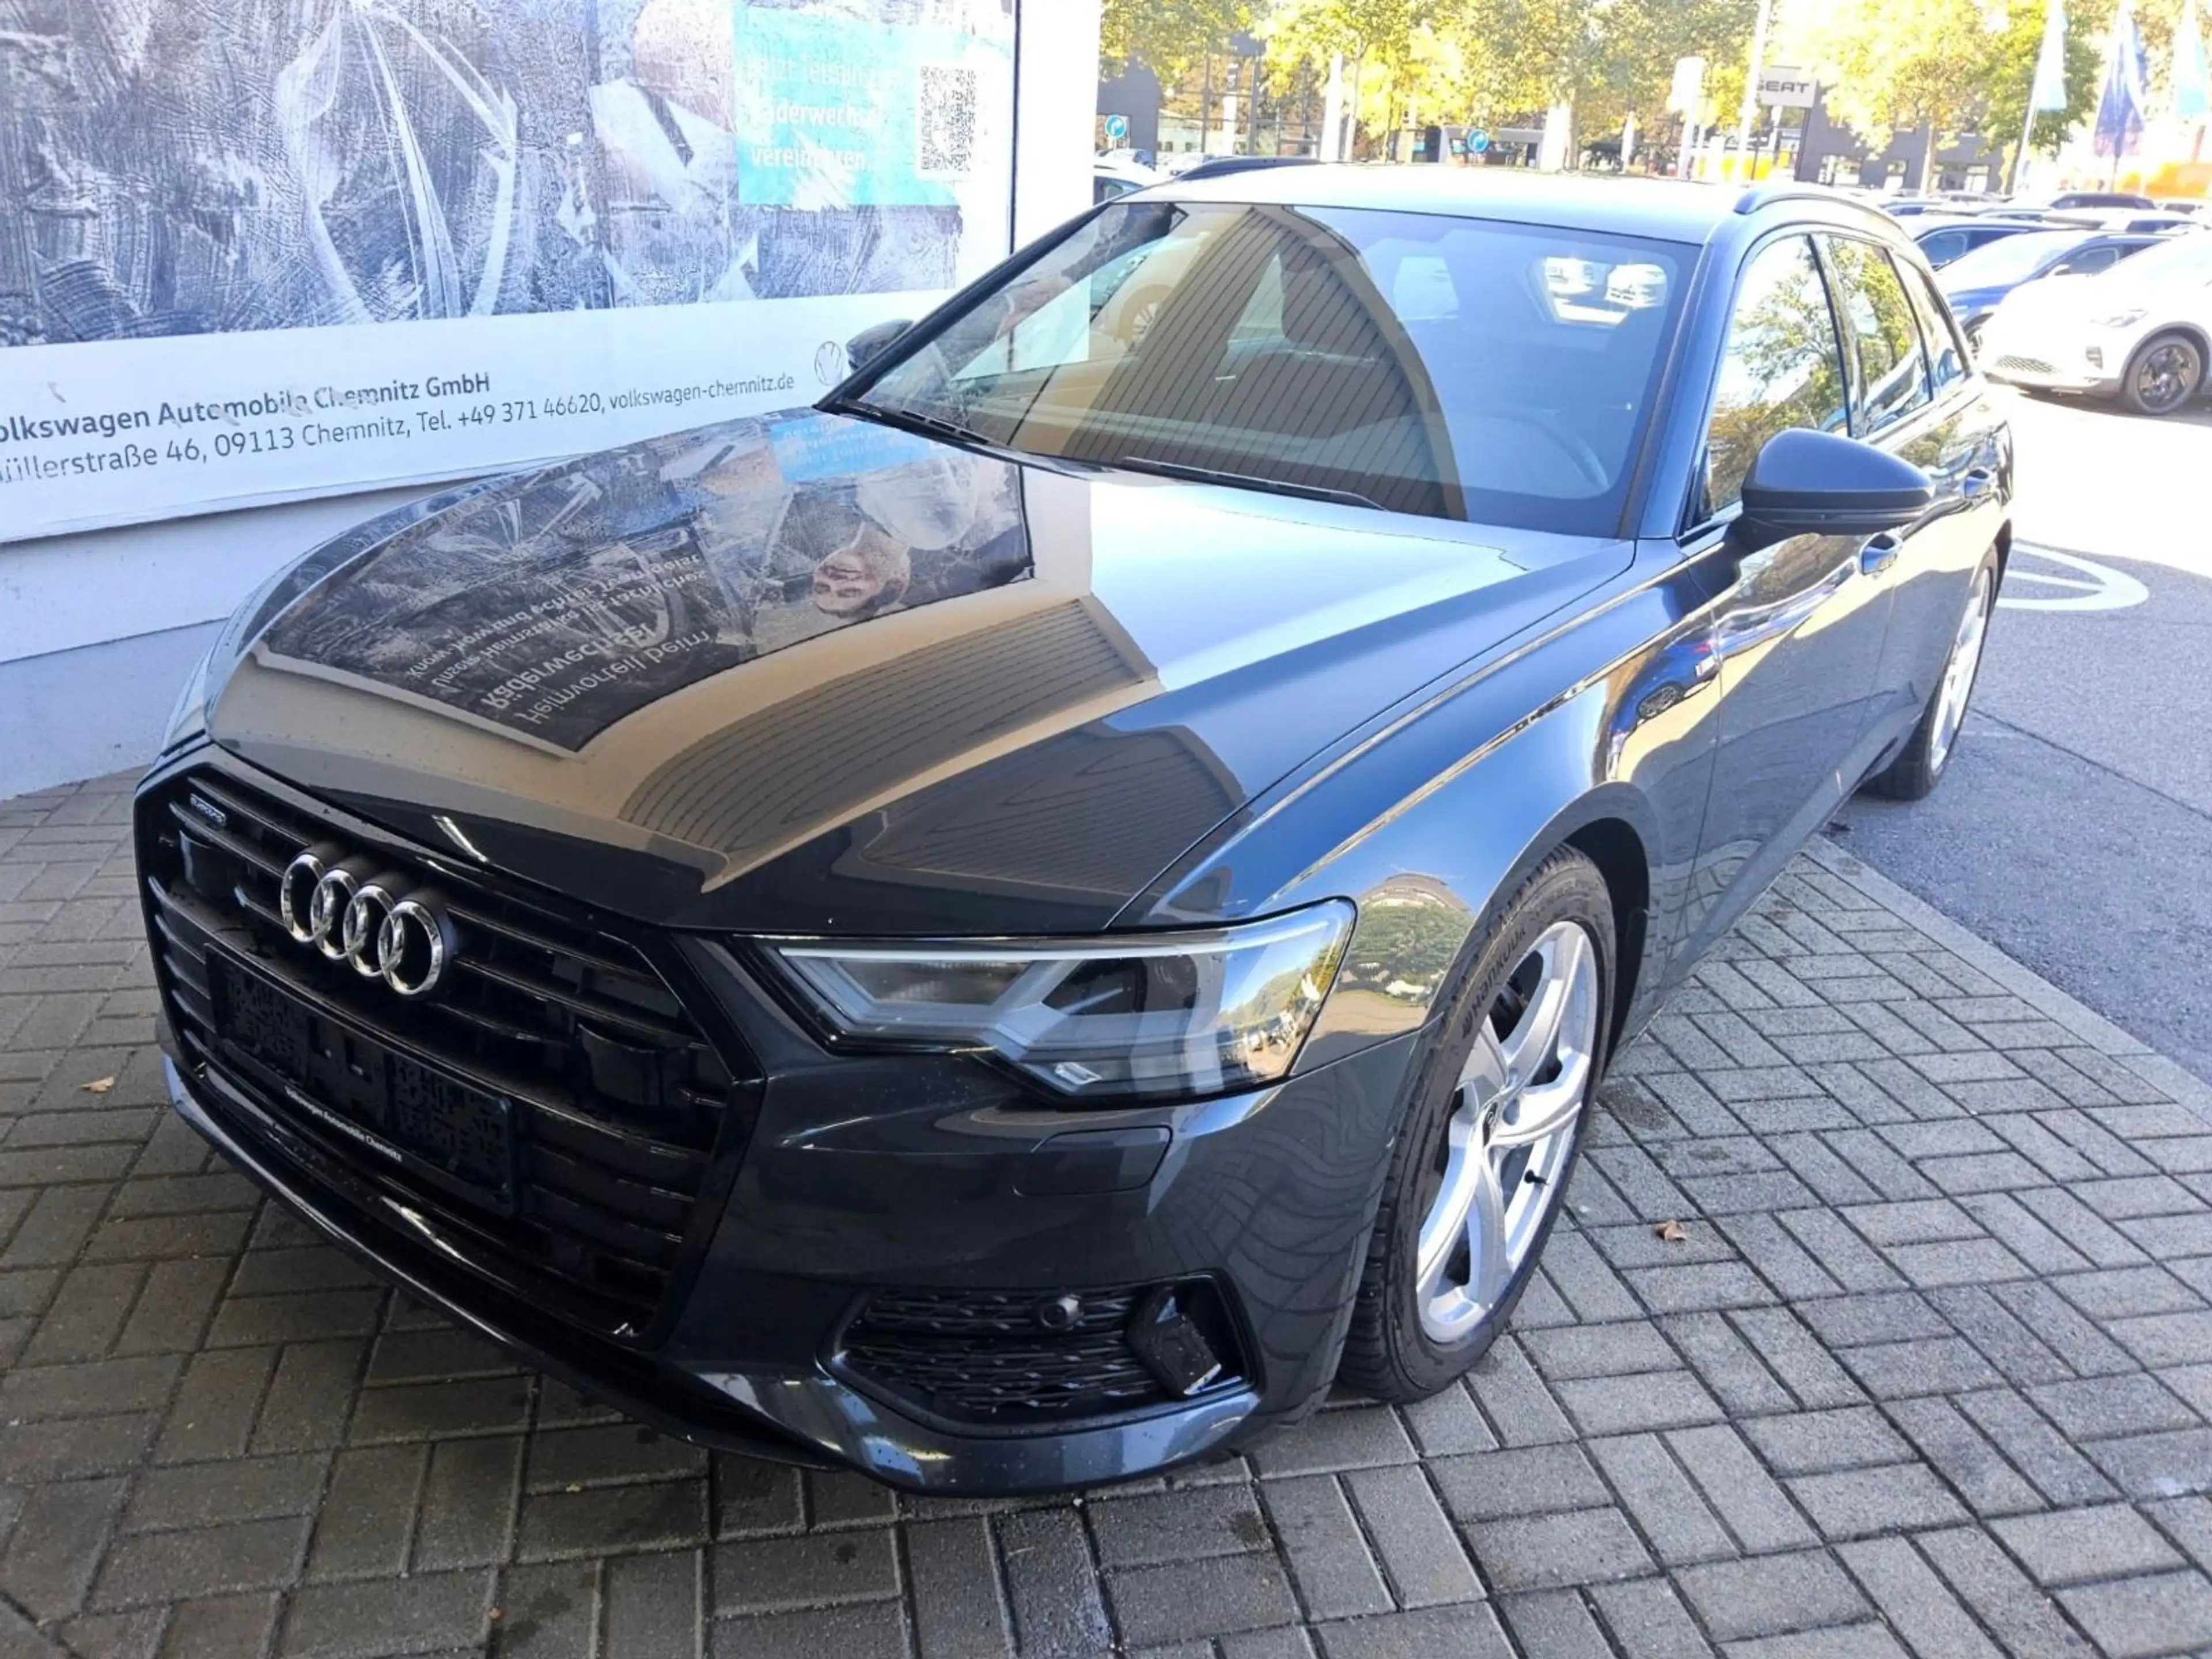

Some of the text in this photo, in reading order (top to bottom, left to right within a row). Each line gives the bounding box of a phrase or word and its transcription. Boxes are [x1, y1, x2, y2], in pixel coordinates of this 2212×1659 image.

[0, 410, 150, 443] olkswagen
[158, 390, 307, 426] Automobile
[426, 372, 490, 398] GmbH
[0, 372, 795, 483] üllerstraße 46, 09113 Chemnitz, Tel. +49 371 46620, volkswagen-chemnitz.de
